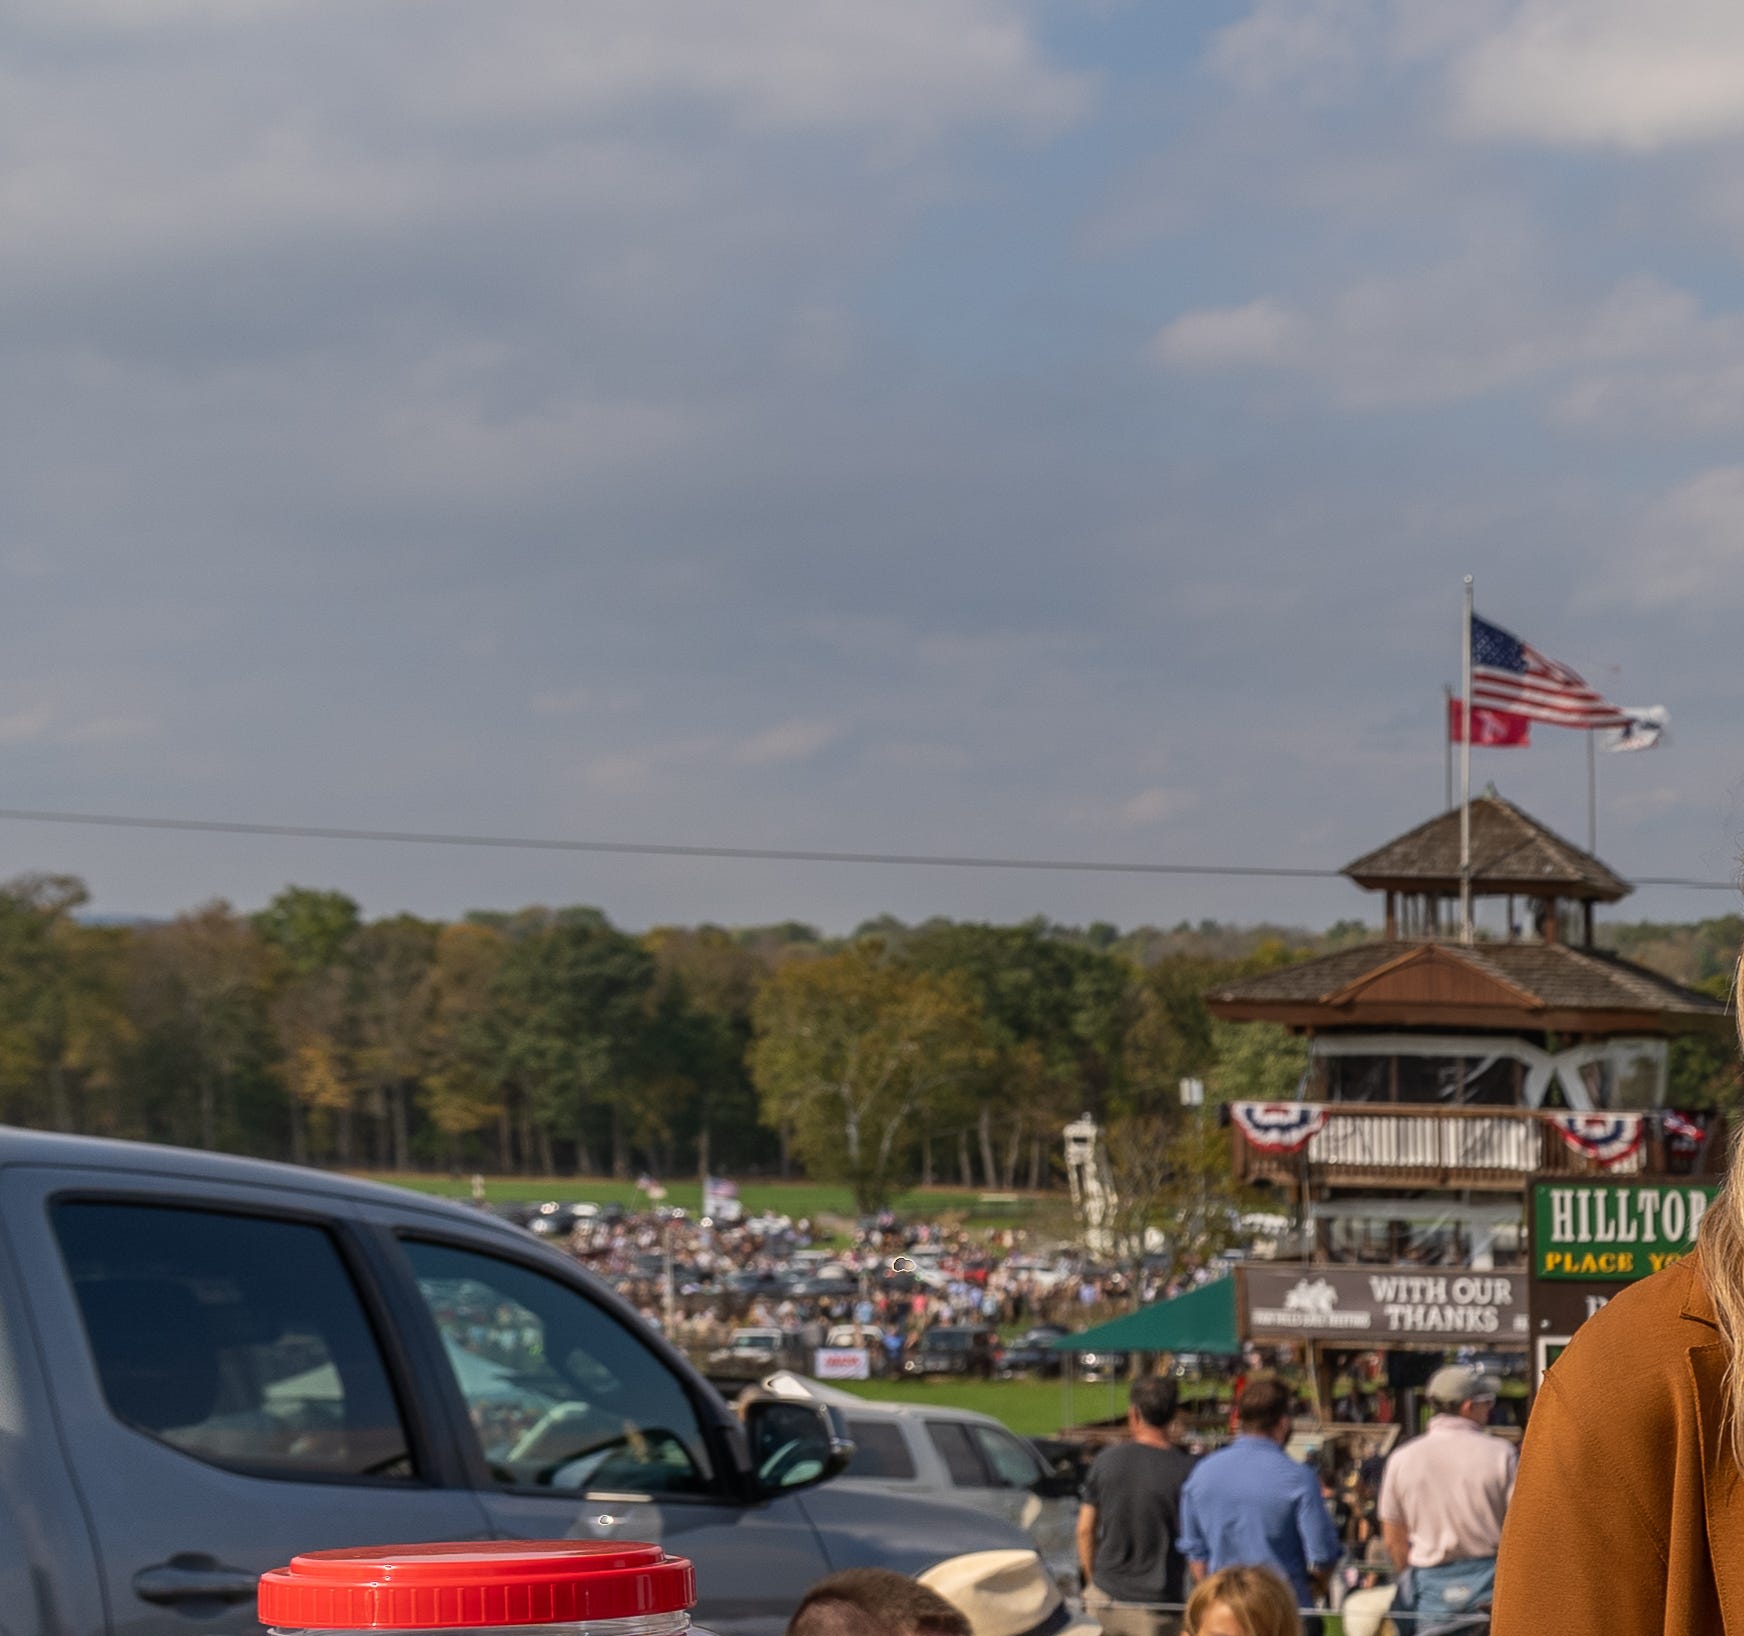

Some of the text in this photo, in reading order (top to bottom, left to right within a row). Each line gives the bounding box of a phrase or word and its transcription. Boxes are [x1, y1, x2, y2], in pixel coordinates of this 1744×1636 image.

[1545, 1252, 1633, 1273] PLACE
[1369, 1275, 1512, 1304] WITH OUR
[1384, 1304, 1499, 1333] THANKS
